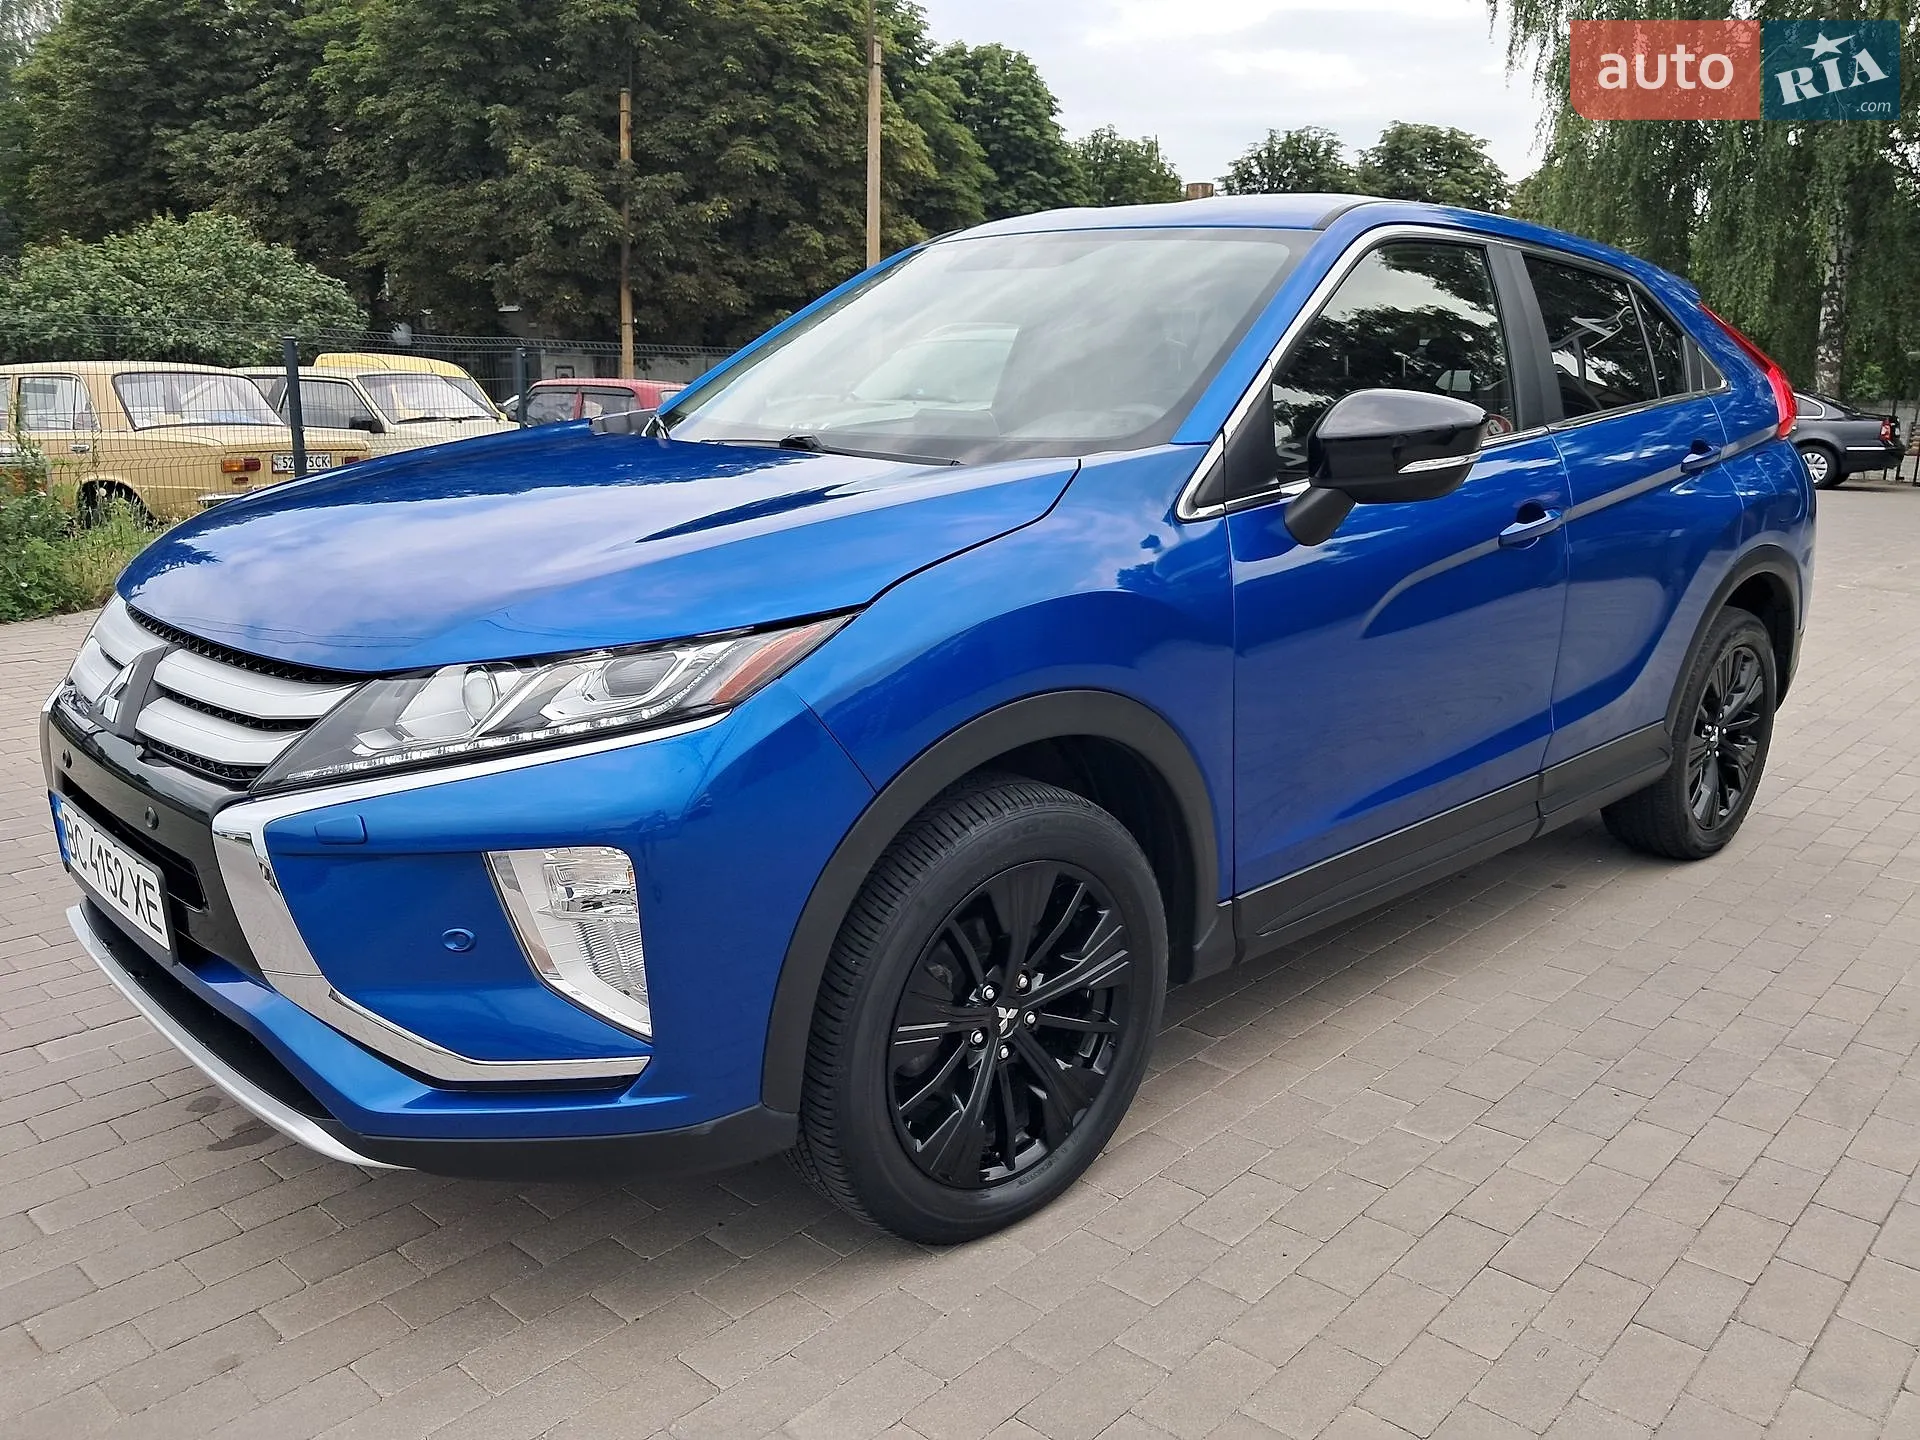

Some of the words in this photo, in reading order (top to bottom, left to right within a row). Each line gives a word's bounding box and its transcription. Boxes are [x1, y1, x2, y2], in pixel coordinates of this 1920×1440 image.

[64, 812, 88, 871] BC
[89, 837, 129, 908] 4152
[128, 866, 163, 935] XE
